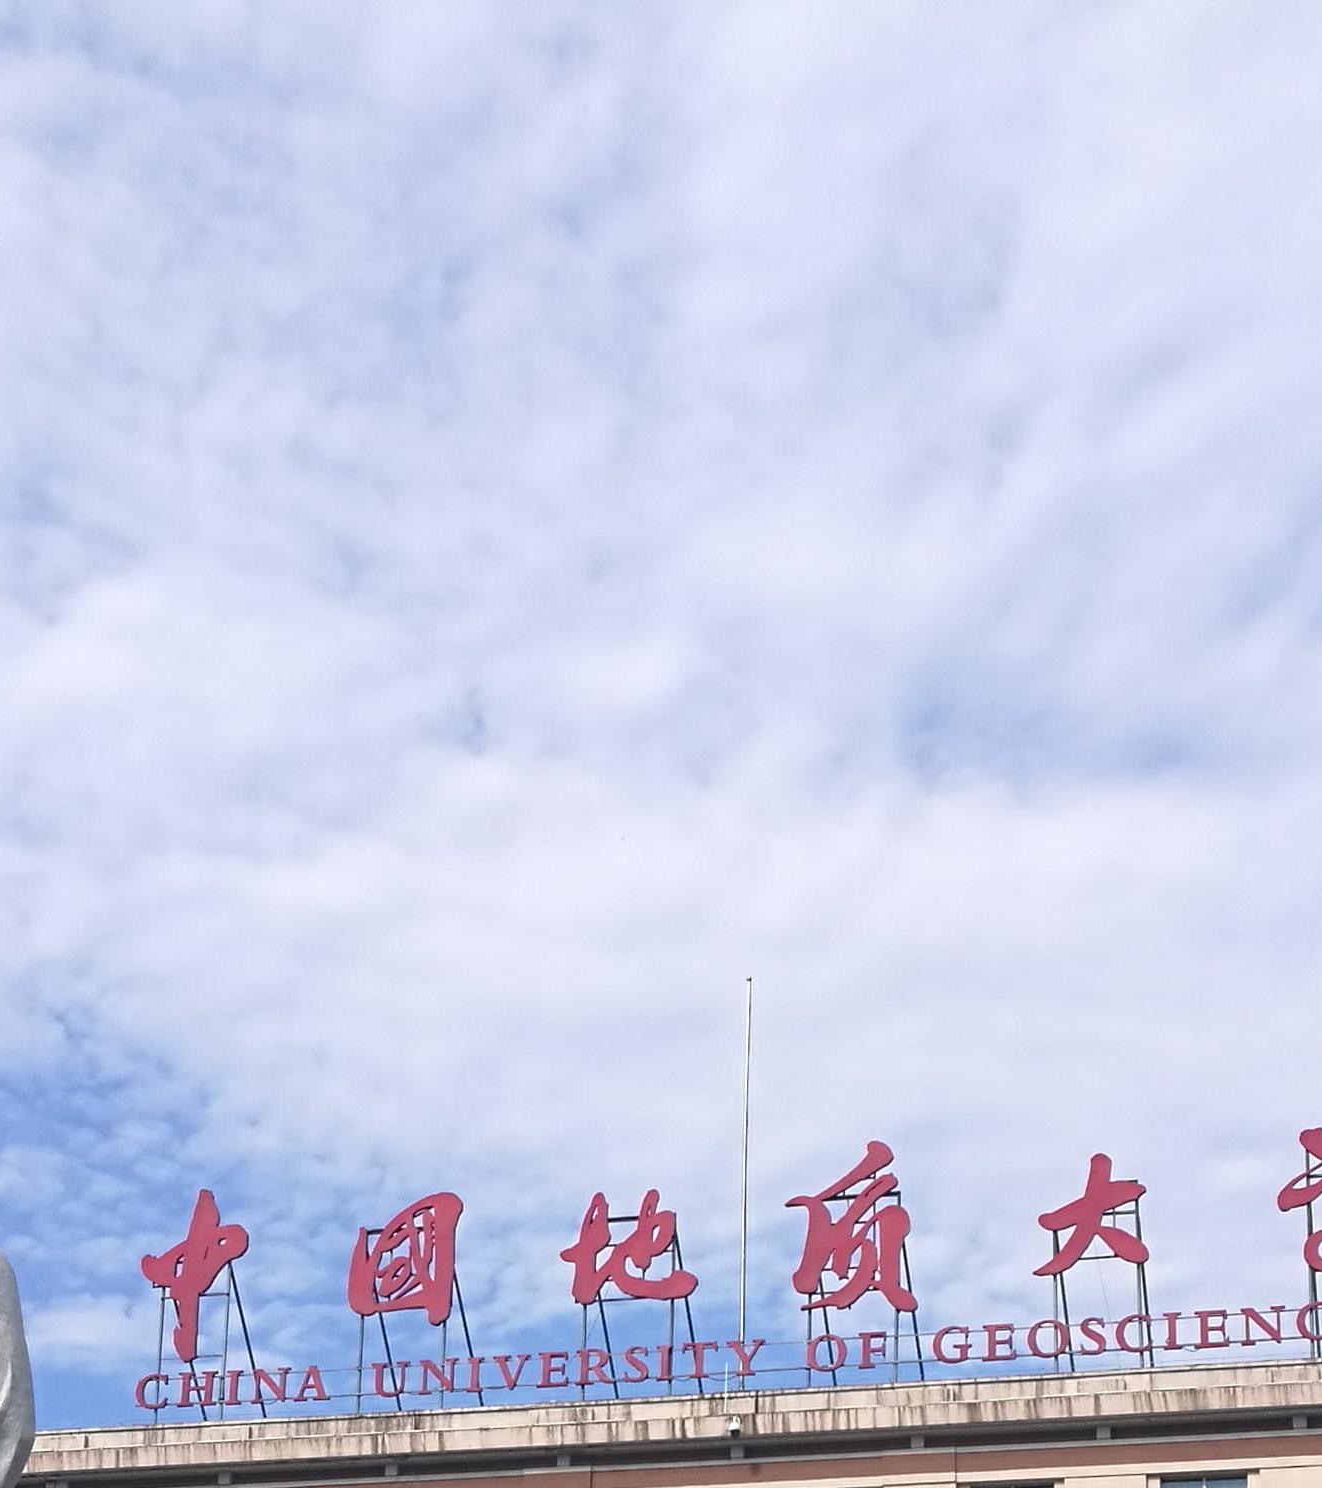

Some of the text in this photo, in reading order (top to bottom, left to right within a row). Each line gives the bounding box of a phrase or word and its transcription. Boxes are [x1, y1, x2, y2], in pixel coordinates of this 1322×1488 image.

[134, 1364, 331, 1410] CHINA
[370, 1338, 764, 1398] UNIVERSITY
[805, 1331, 888, 1372] OF
